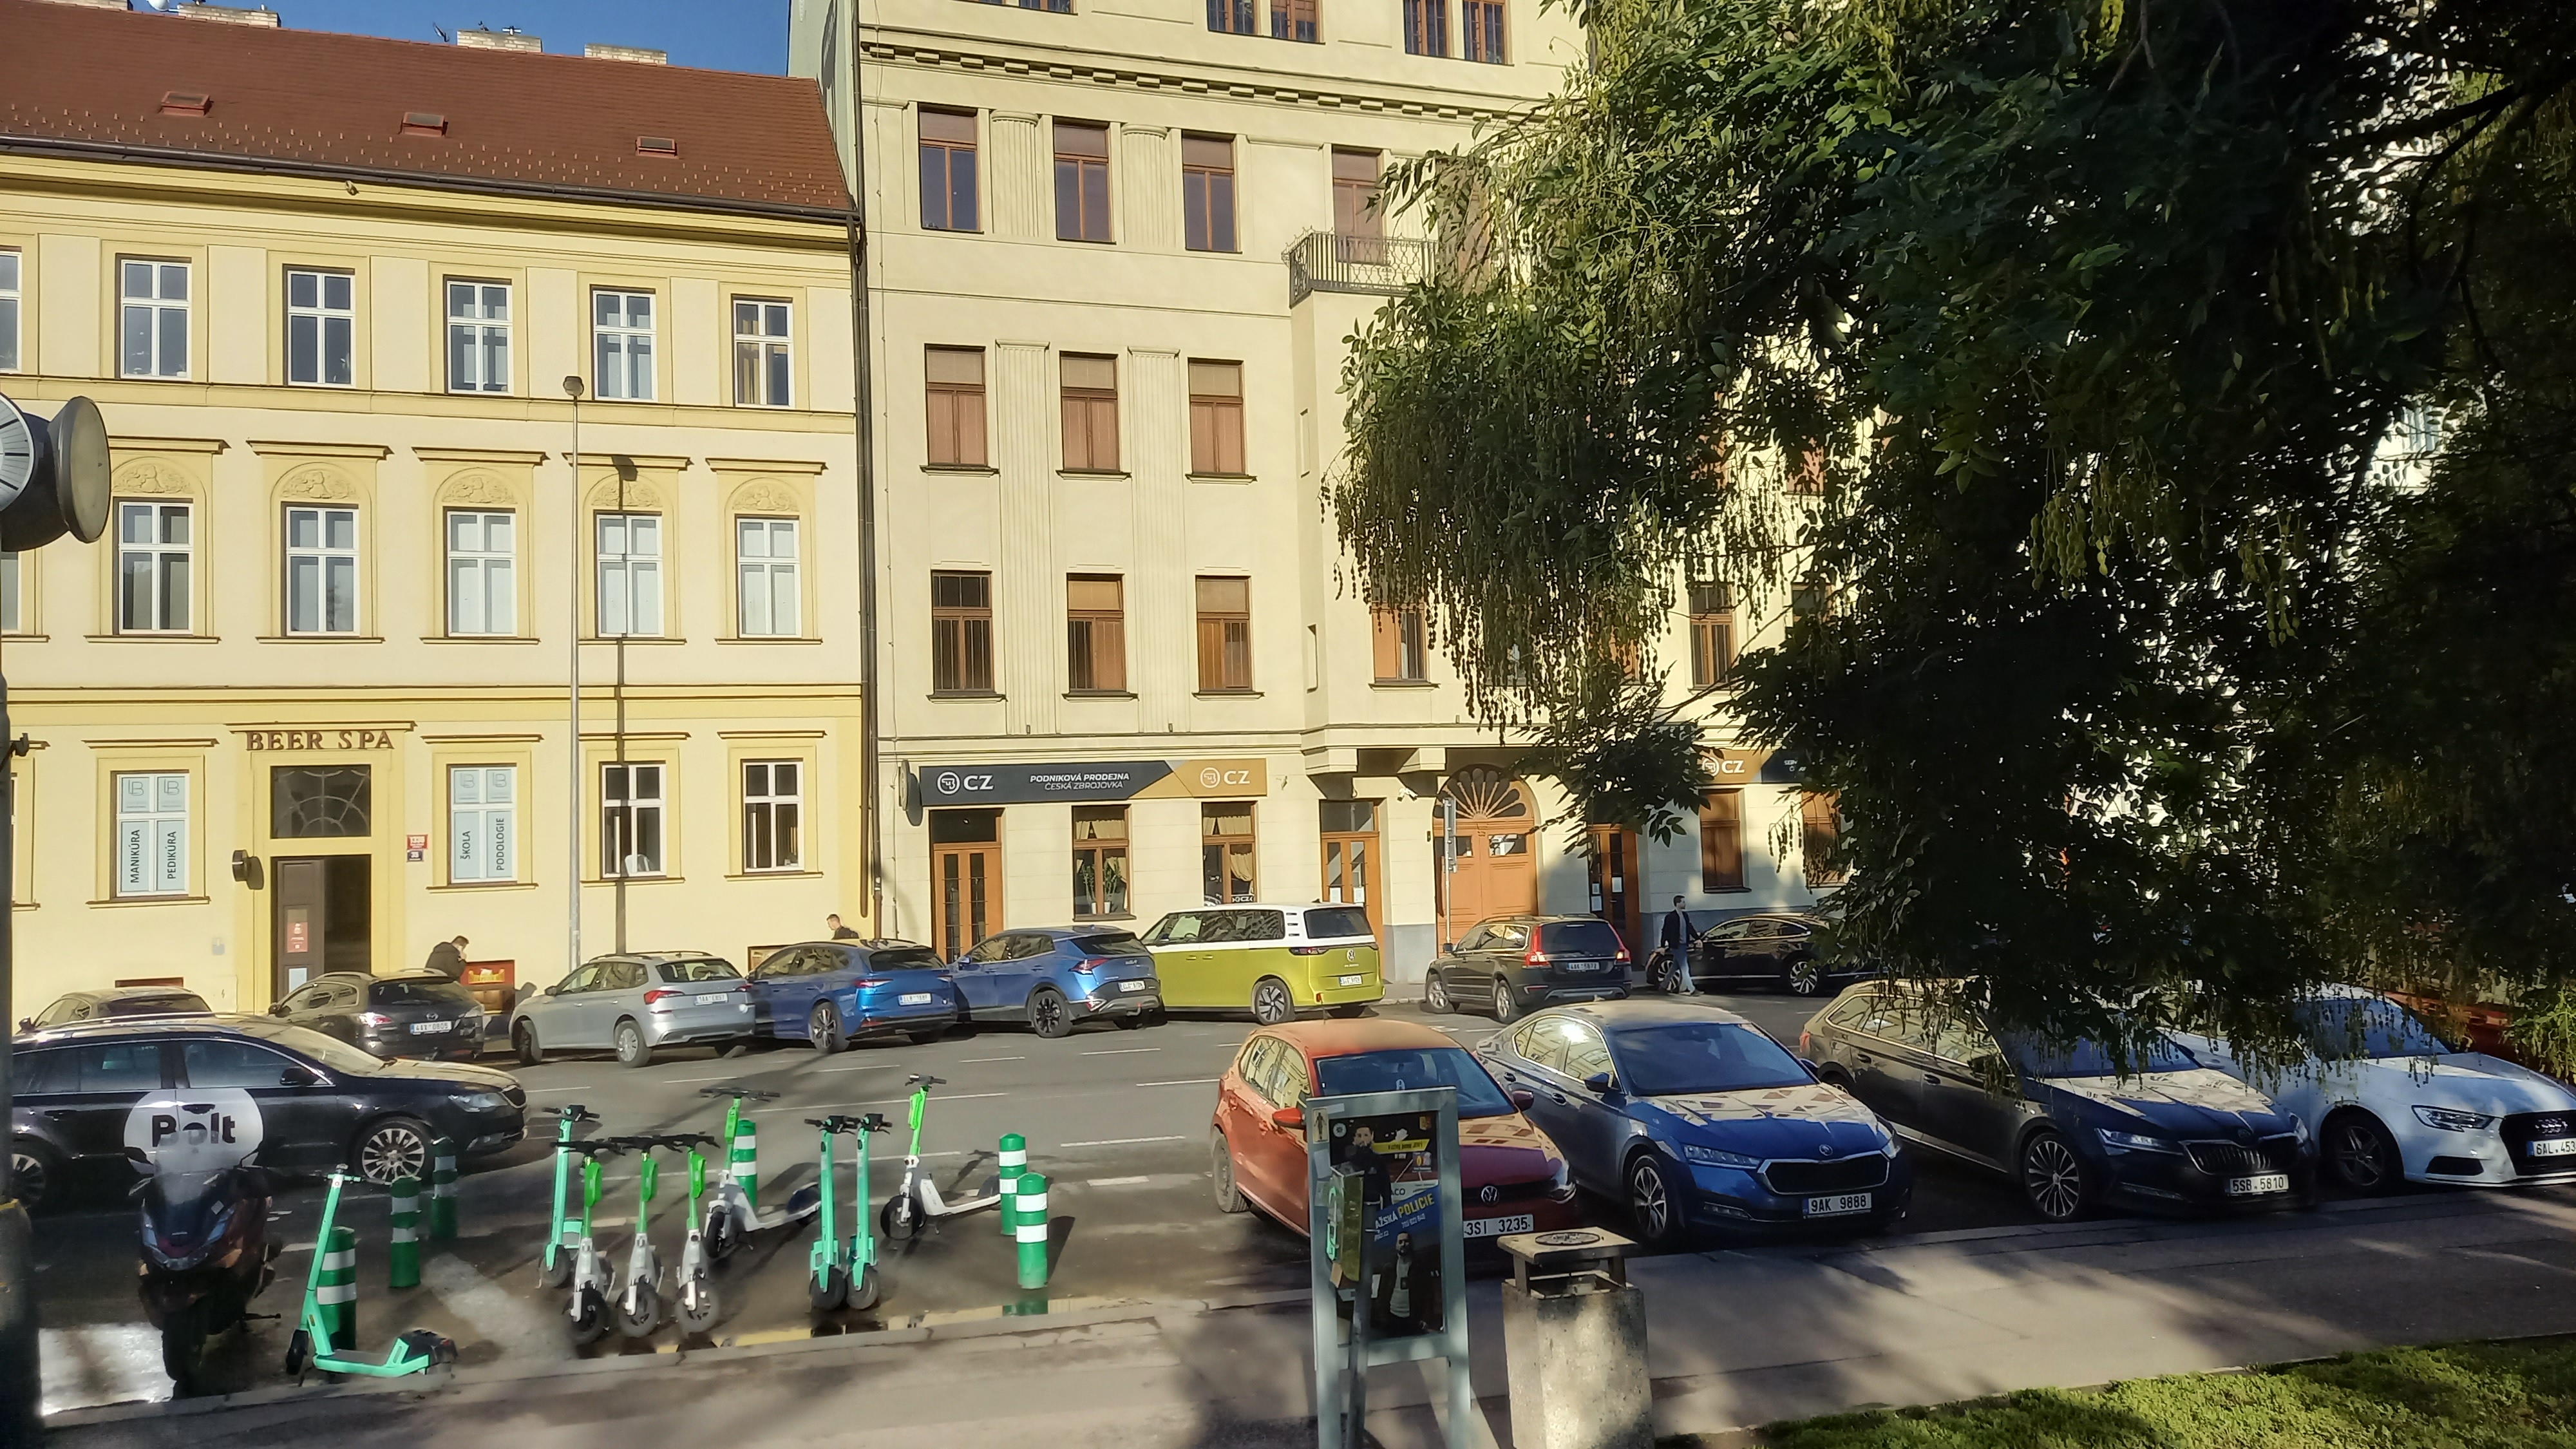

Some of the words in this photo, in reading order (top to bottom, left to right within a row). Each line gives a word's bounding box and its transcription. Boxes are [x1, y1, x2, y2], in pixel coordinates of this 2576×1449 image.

[245, 731, 324, 750] BEER
[338, 730, 394, 749] SPA
[1721, 760, 1745, 773] CZ
[963, 775, 994, 791] CZ
[1030, 773, 1082, 782] PODNIKOVÁ
[1083, 773, 1130, 781] PRODEJNA
[1224, 770, 1251, 784] CZ
[1045, 781, 1072, 790] ČESKÁ
[1073, 781, 1123, 790] ZBROJOVKA
[460, 831, 471, 860] ŠKOLA
[496, 818, 504, 871] PODOLOGIE
[129, 829, 140, 883] MANIKÚRA
[165, 831, 176, 878] PEDIKÚRA
[152, 1112, 236, 1148] Bolt
[2536, 1143, 2553, 1155] 6AL
[2561, 1141, 2576, 1153] 453
[2232, 1179, 2251, 1193] 5SB
[2260, 1177, 2284, 1190] 5810
[1397, 1193, 1435, 1218] POLICIE
[1811, 1198, 1832, 1212] 9AK
[1840, 1195, 1866, 1209] 9888
[1498, 1217, 1528, 1233] 3235
